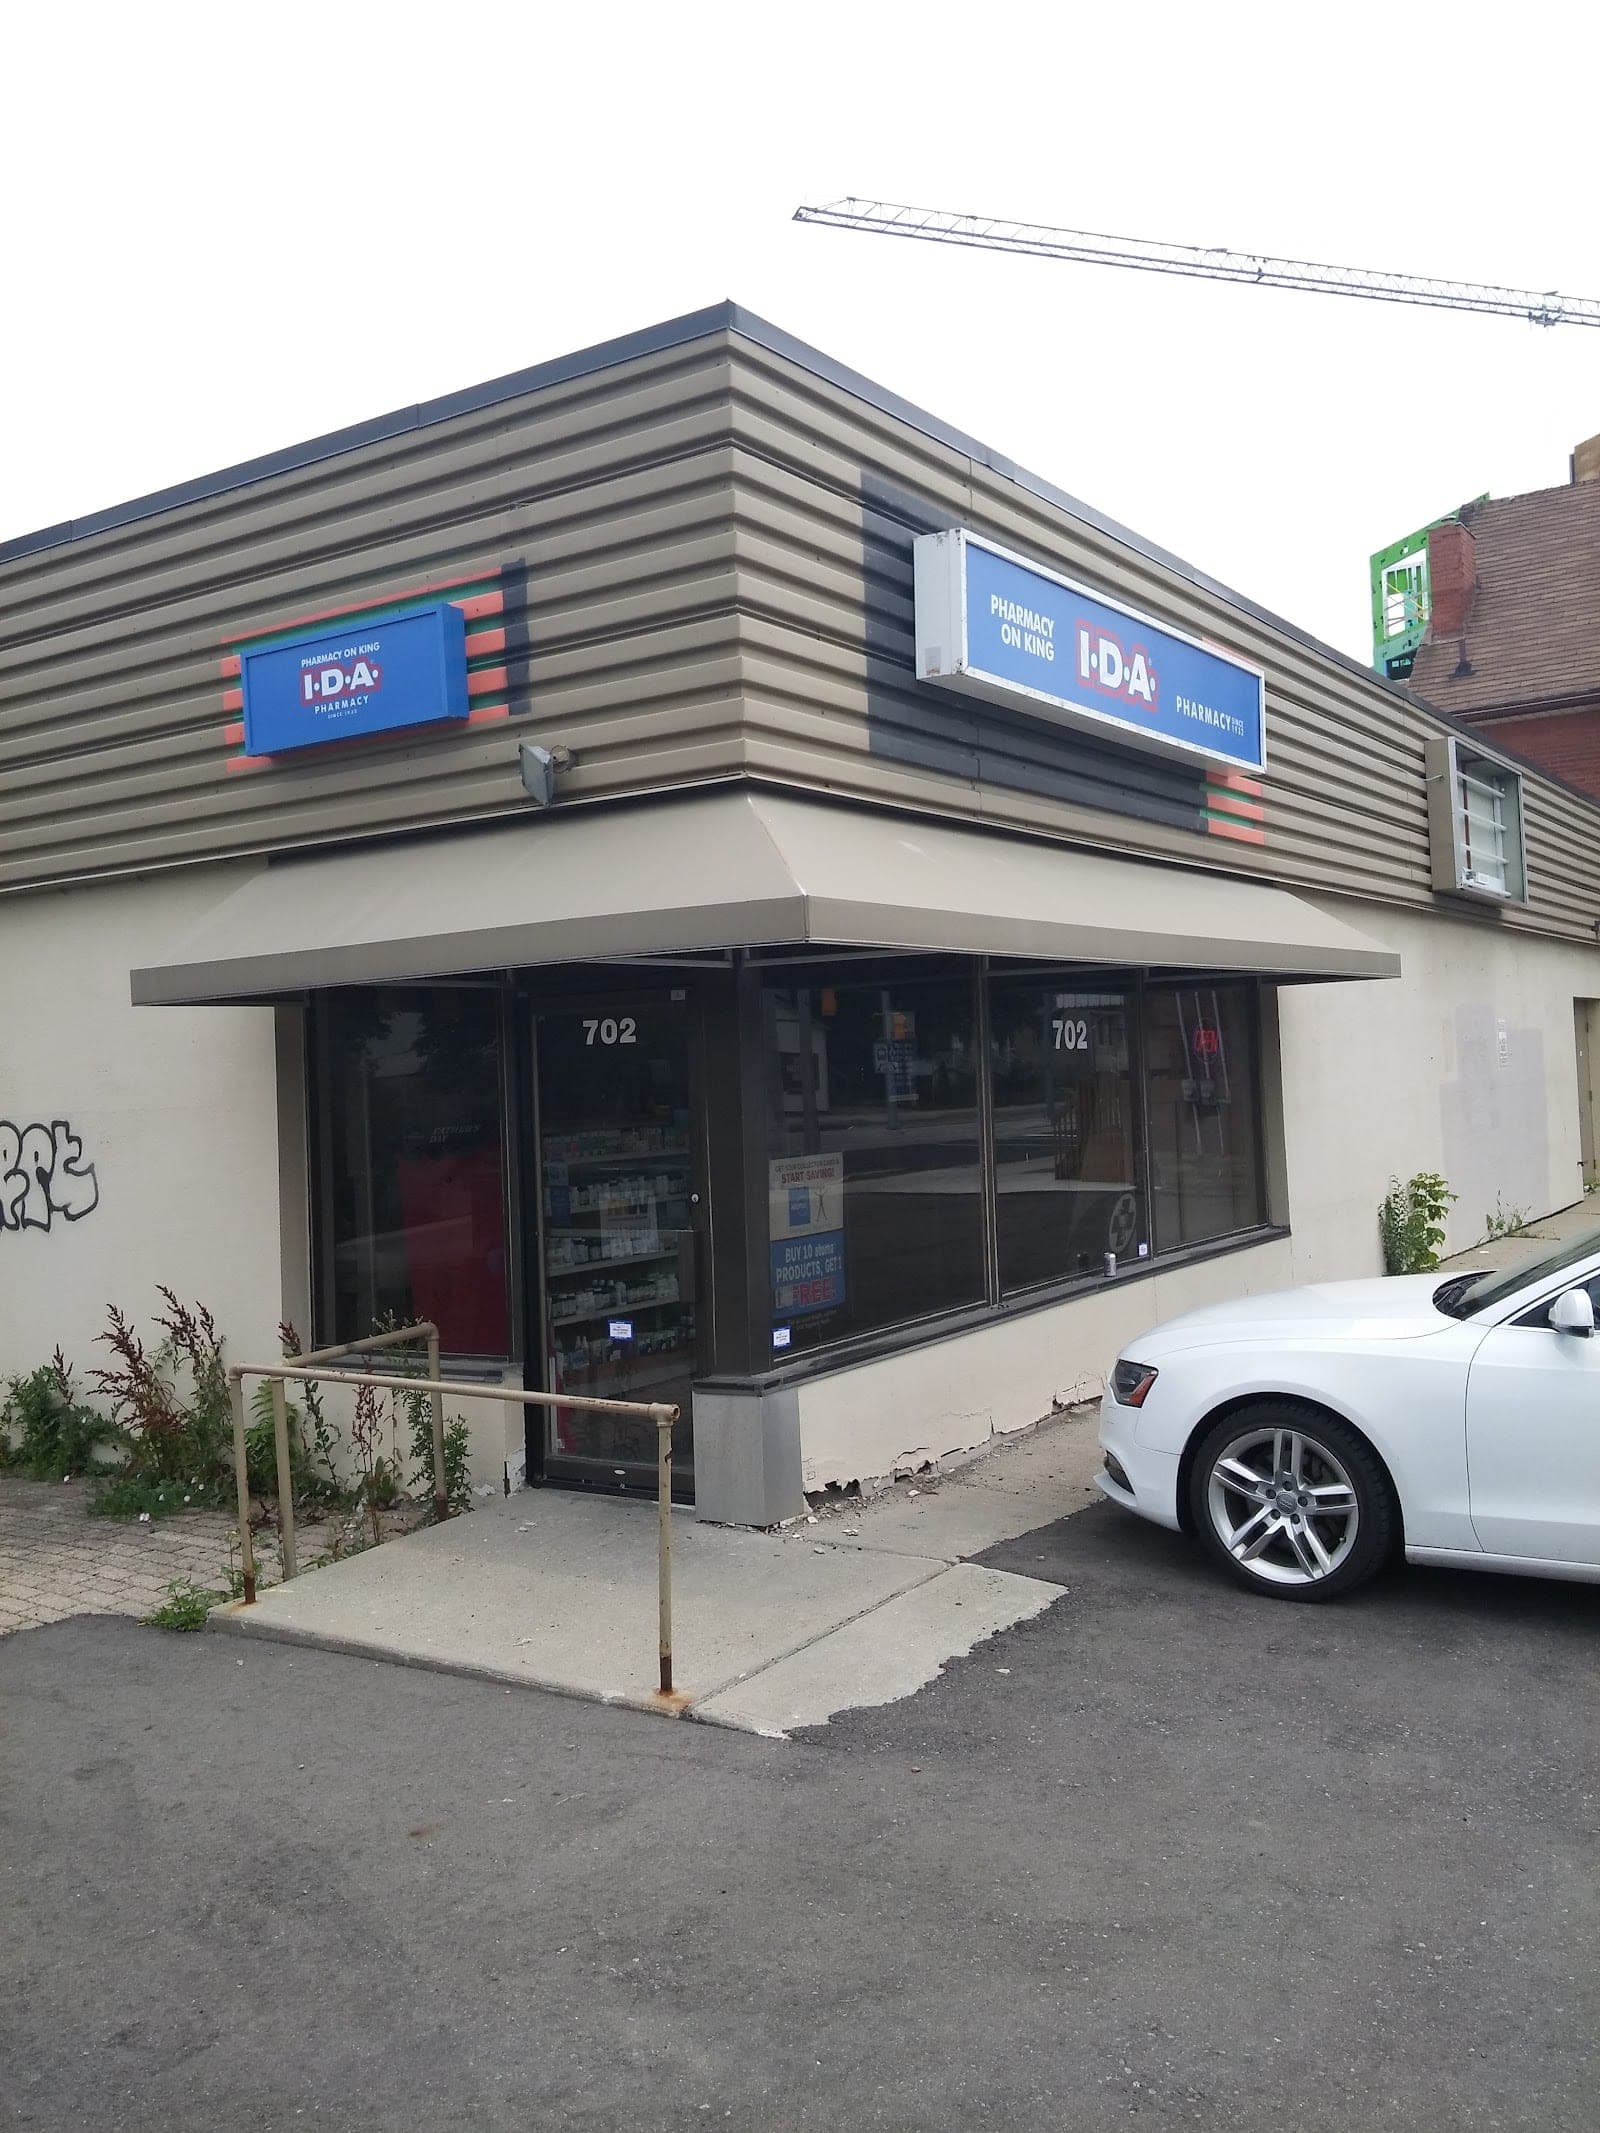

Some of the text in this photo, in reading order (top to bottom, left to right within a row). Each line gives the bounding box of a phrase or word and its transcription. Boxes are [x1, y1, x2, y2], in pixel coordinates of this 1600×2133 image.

[991, 593, 1055, 639] PHARMACY
[301, 641, 380, 668] PHARMACY ON KING
[1001, 623, 1055, 662] ON KING
[314, 695, 369, 714] PHARMACY
[1176, 695, 1231, 731] PHARMACY
[582, 1018, 638, 1046] 702
[1052, 1020, 1088, 1050] 702
[781, 1167, 835, 1184] START SAVING!
[785, 1245, 801, 1263] BUY
[803, 1243, 813, 1260] 10
[776, 1260, 823, 1283] PRODUCTS,
[825, 1257, 837, 1274] GET
